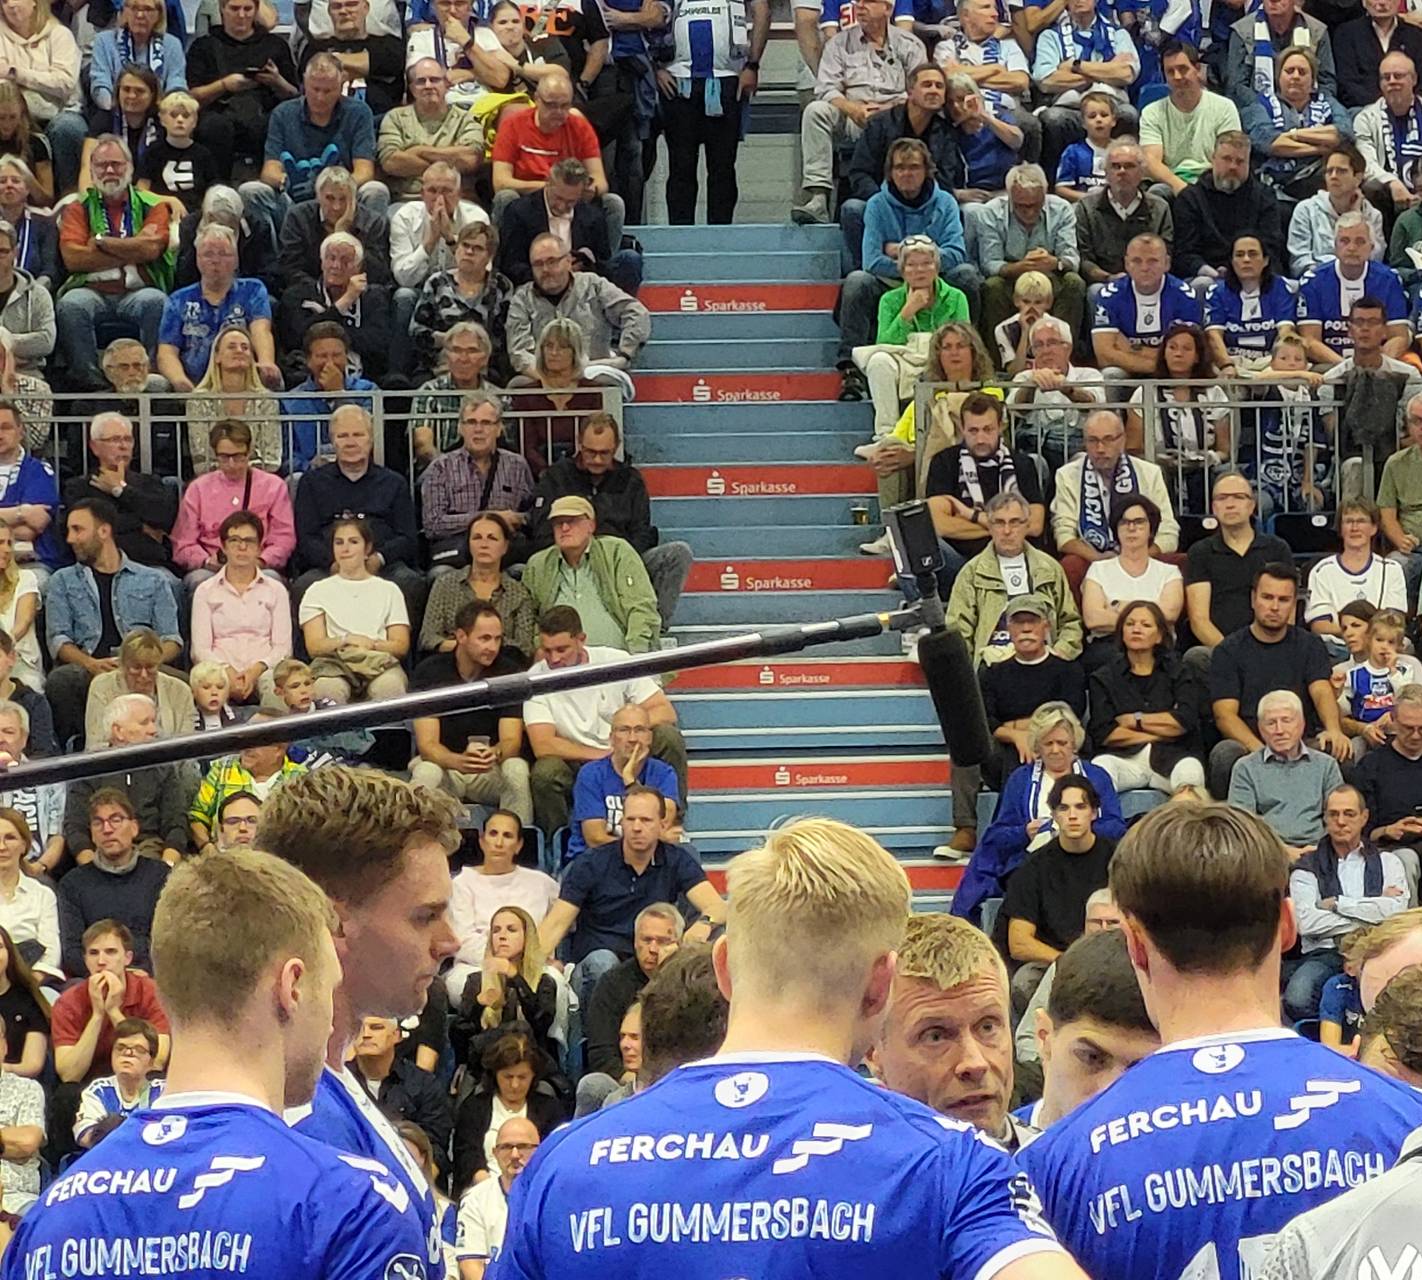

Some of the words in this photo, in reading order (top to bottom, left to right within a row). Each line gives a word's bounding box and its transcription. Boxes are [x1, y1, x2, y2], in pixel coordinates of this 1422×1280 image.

[703, 299, 767, 313] Sparkasse
[717, 388, 781, 402] Sparkasse
[731, 482, 796, 496] Sparkasse
[746, 577, 812, 592] Sparkasse
[779, 673, 831, 685] Sparkasse
[795, 774, 848, 785] Sparkasse
[1090, 1091, 1263, 1153] FERCHAU
[590, 1133, 769, 1166] FERCHAU
[46, 1168, 177, 1207] FERCHAU
[1089, 1187, 1142, 1236] VFL
[1146, 1151, 1387, 1214] GUMMERSBACH
[570, 1203, 621, 1252] VFL
[627, 1198, 876, 1246] GUMMERSBACH
[24, 1248, 57, 1280] VFL
[60, 1231, 252, 1278] GUMMERSBACH
